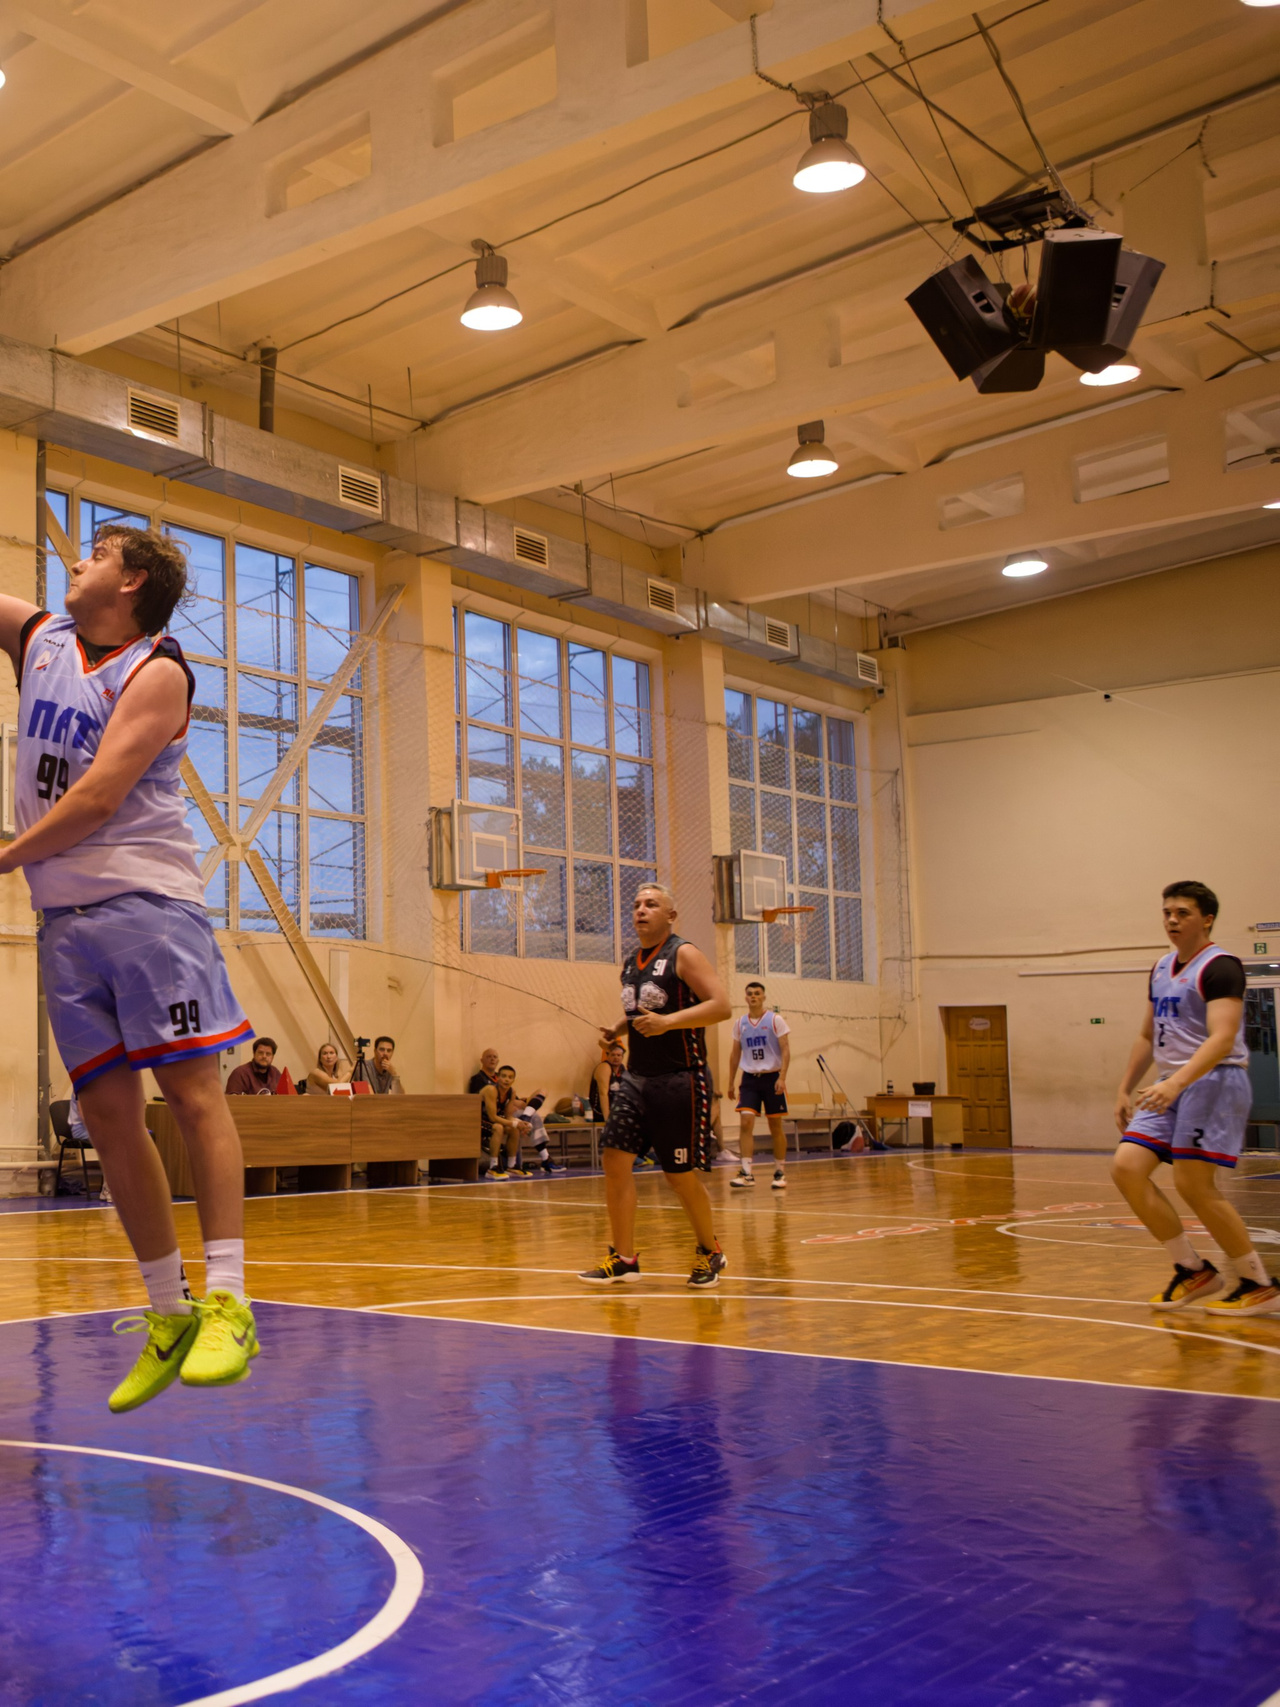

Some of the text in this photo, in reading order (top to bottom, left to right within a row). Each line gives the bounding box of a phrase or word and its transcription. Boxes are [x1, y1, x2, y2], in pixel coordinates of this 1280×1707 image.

[36, 753, 70, 802] 99
[652, 959, 668, 976] 91
[169, 999, 201, 1037] 99
[1193, 1128, 1204, 1148] 2
[674, 1148, 688, 1164] 91
